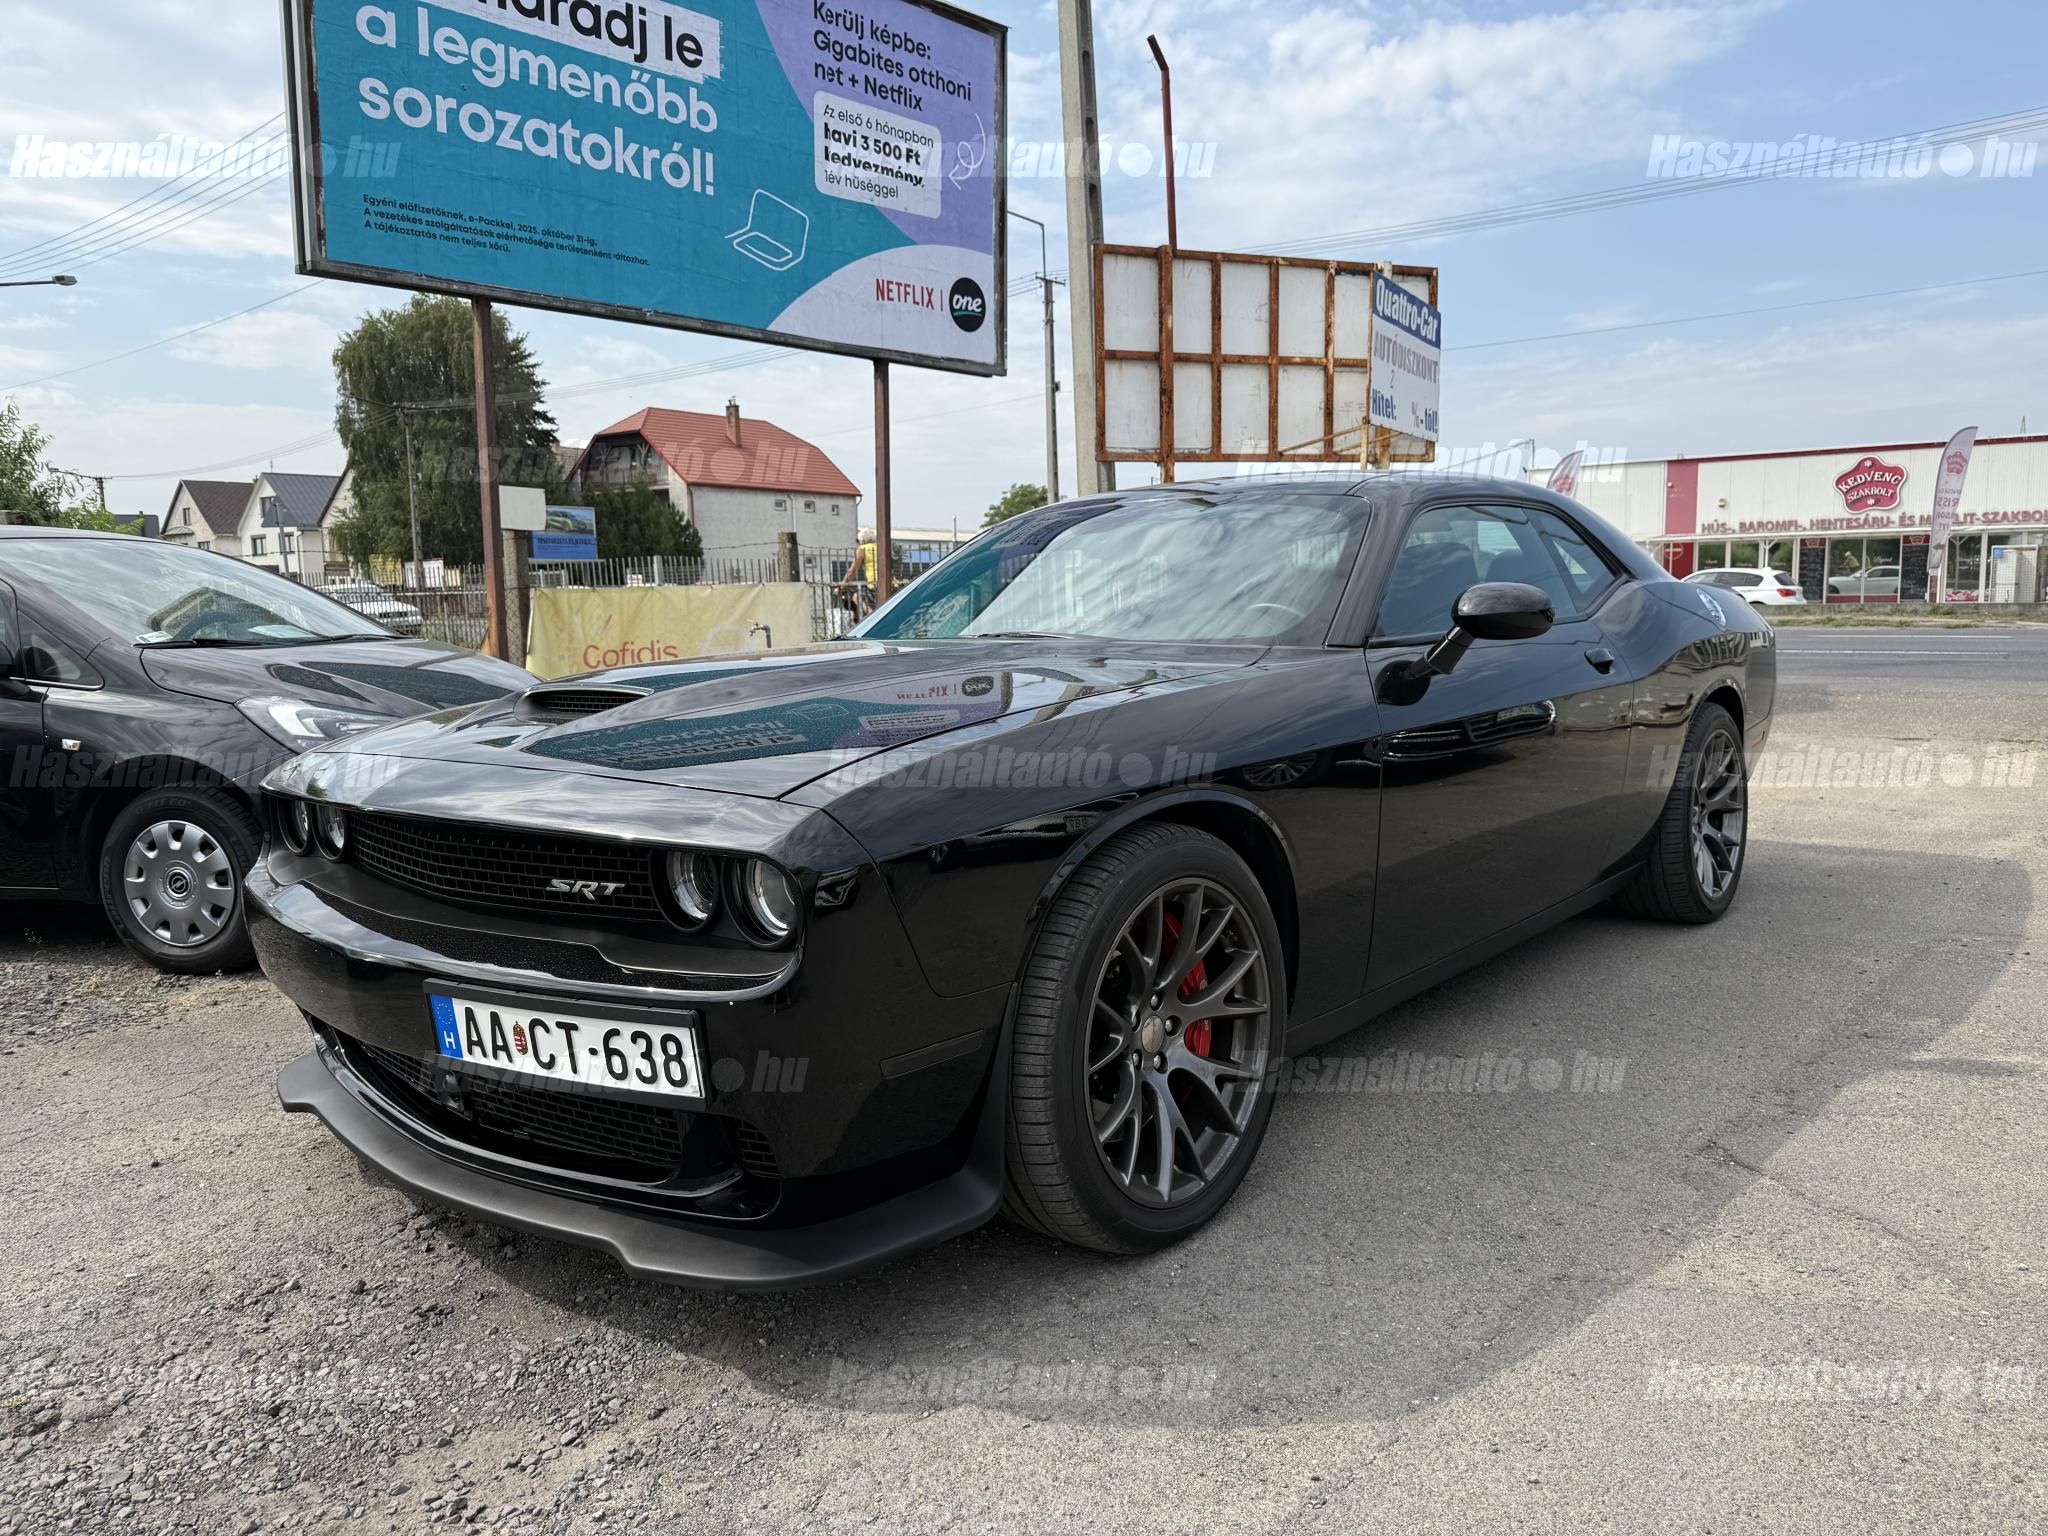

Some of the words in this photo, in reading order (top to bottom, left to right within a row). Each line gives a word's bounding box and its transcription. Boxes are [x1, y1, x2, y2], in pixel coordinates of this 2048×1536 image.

[478, 0, 648, 63] aradj
[664, 15, 704, 69] le
[813, 0, 865, 41] Kerülj
[870, 19, 932, 60] képbe:
[355, 5, 397, 48] a
[417, 7, 718, 133] legmenőbb
[813, 29, 904, 78] Gigabites
[908, 66, 972, 102] otthoni
[814, 62, 844, 87] net
[848, 73, 859, 88] +
[864, 74, 923, 113] Netflix
[359, 77, 716, 196] sorozatokról!
[824, 104, 835, 119] Az
[838, 110, 863, 127] első
[866, 117, 873, 130] 6
[875, 118, 934, 148] hónapban
[824, 122, 857, 148] havi
[861, 134, 870, 151] 3
[873, 138, 903, 160] 500
[906, 147, 921, 166] Ft
[845, 174, 899, 199] hűséggel
[363, 194, 397, 207] Egyéni
[517, 223, 540, 236] 2025.
[541, 228, 575, 241] október
[576, 234, 597, 248] 31-ig.
[363, 208, 372, 216] A
[373, 209, 423, 225] vezetékes
[425, 218, 496, 239] szolgáltatások
[496, 231, 555, 249] elérhetősége
[556, 241, 612, 260] területenként
[364, 219, 373, 229] A
[374, 221, 437, 240] tájékoztatás
[439, 232, 460, 243] nem
[462, 236, 487, 249] teljes
[876, 278, 935, 310] NETFLIX
[952, 294, 983, 313] one
[1376, 278, 1439, 342] Quattro-Car
[1374, 330, 1439, 385] AUTÓDISZKONT
[1838, 470, 1901, 493] KEDVENC
[1846, 486, 1895, 503] SZAKBOLT
[1898, 511, 1915, 528] ÉS
[582, 640, 679, 669] Cofidis
[545, 878, 627, 901] SRT
[443, 1031, 457, 1050] H
